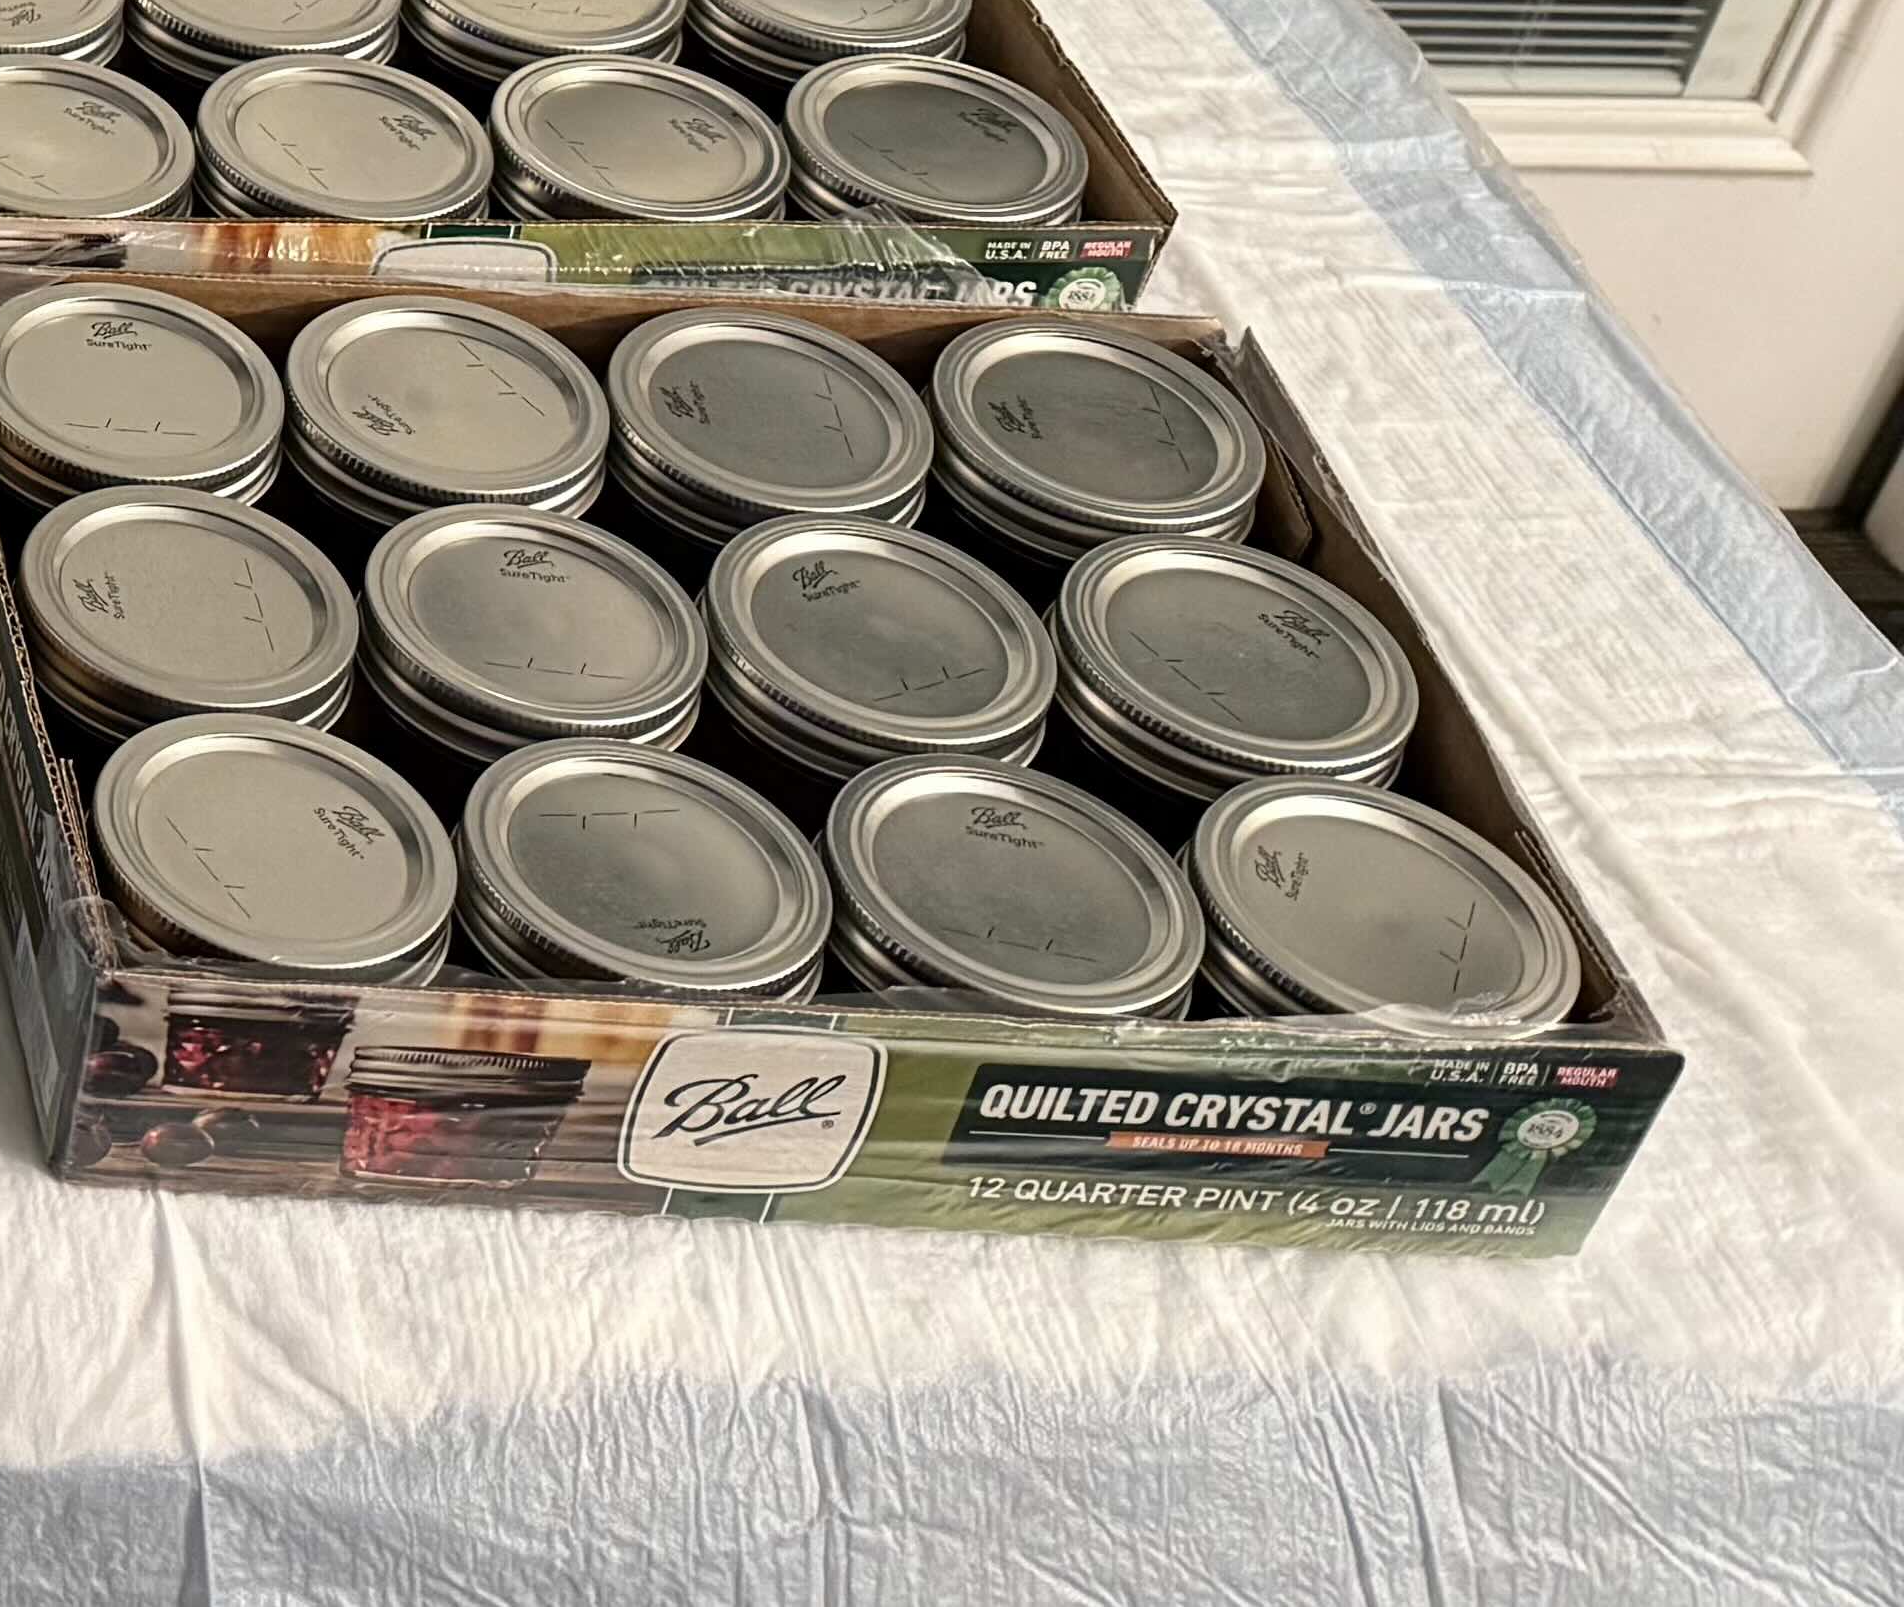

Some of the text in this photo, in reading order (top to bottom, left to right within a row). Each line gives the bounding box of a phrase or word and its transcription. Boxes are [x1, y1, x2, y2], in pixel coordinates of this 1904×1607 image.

[984, 249, 1028, 261] U.S.A.
[1038, 250, 1070, 260] FREE
[92, 321, 138, 339] Ball
[504, 550, 553, 568] Ball
[793, 560, 839, 591] Ball
[72, 579, 108, 617] Ball
[333, 805, 384, 845] Ball
[970, 806, 1028, 829] Ball
[1429, 1068, 1486, 1084] U.S.A.
[1474, 1061, 1491, 1073] IN
[1503, 1062, 1540, 1076] BPA
[1556, 1065, 1619, 1078] REGULAR
[1498, 1073, 1538, 1087] FREE
[1559, 1076, 1607, 1088] MOUTH
[651, 1074, 846, 1146] Ball
[979, 1083, 1160, 1125] QUILTED
[1367, 1102, 1490, 1142] JARS
[1131, 1135, 1176, 1149] SEALS
[1178, 1137, 1199, 1150] UP
[1243, 1141, 1305, 1156] MONTHS
[968, 1176, 1546, 1226] 12 QUARTER PINT (4 oz 118 ml)
[1325, 1217, 1366, 1230] JARS
[1367, 1219, 1409, 1232] WITH
